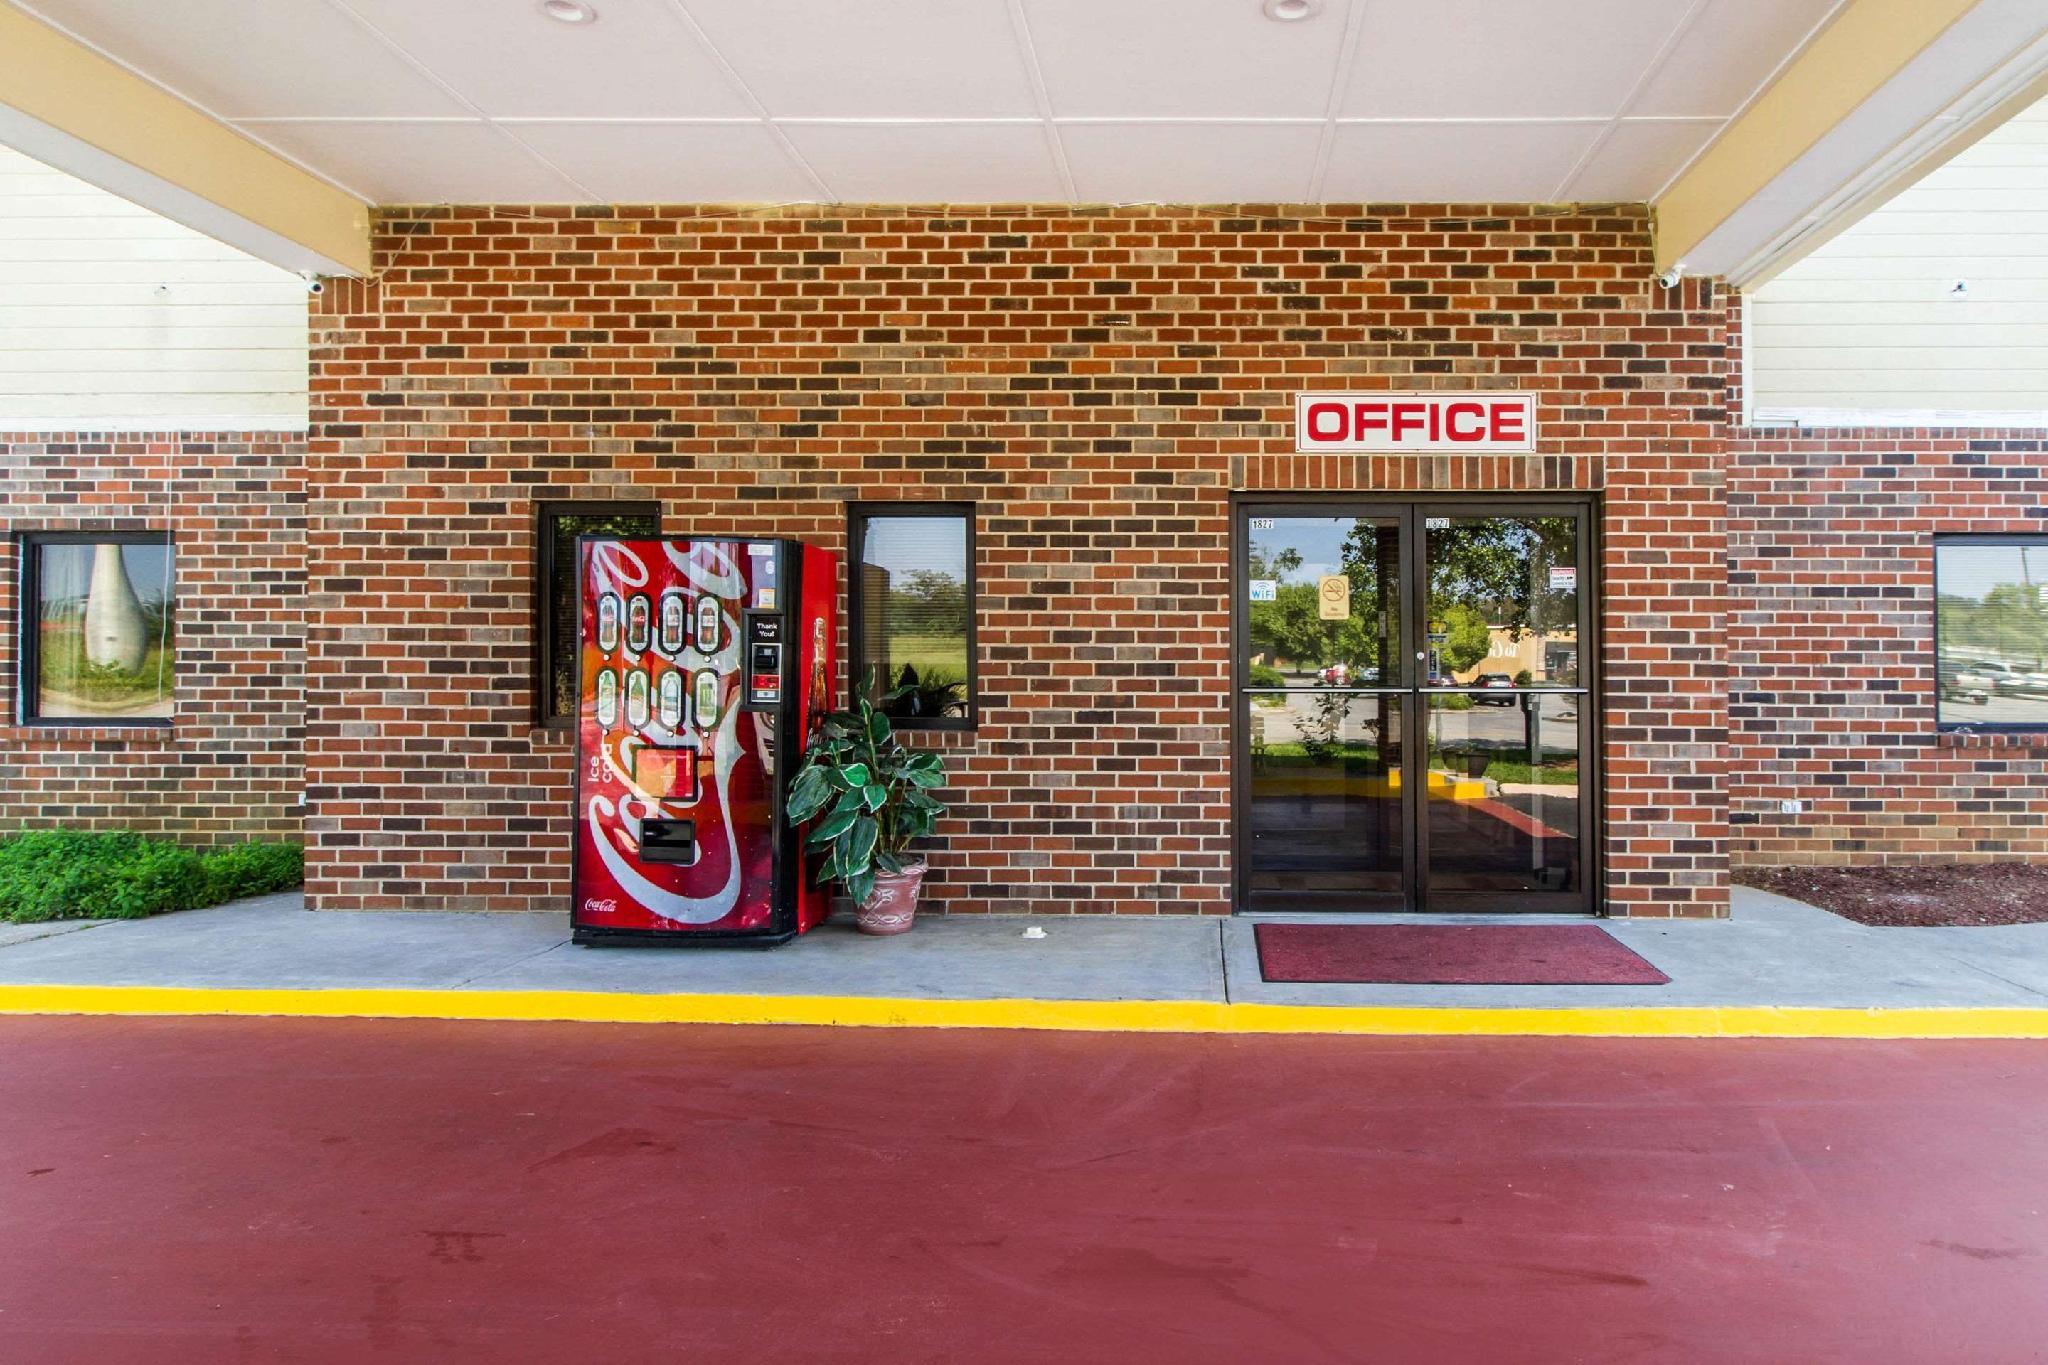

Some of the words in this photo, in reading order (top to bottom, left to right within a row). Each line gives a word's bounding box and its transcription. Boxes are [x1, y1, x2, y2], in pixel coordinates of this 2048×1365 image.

[1307, 402, 1525, 442] OFFICE
[1253, 519, 1273, 529] 1827
[1427, 518, 1448, 528] 1827
[1252, 590, 1274, 599] WiFi
[587, 756, 599, 782] Ice
[600, 744, 612, 783] cold
[585, 897, 617, 912] Coca-Cola
